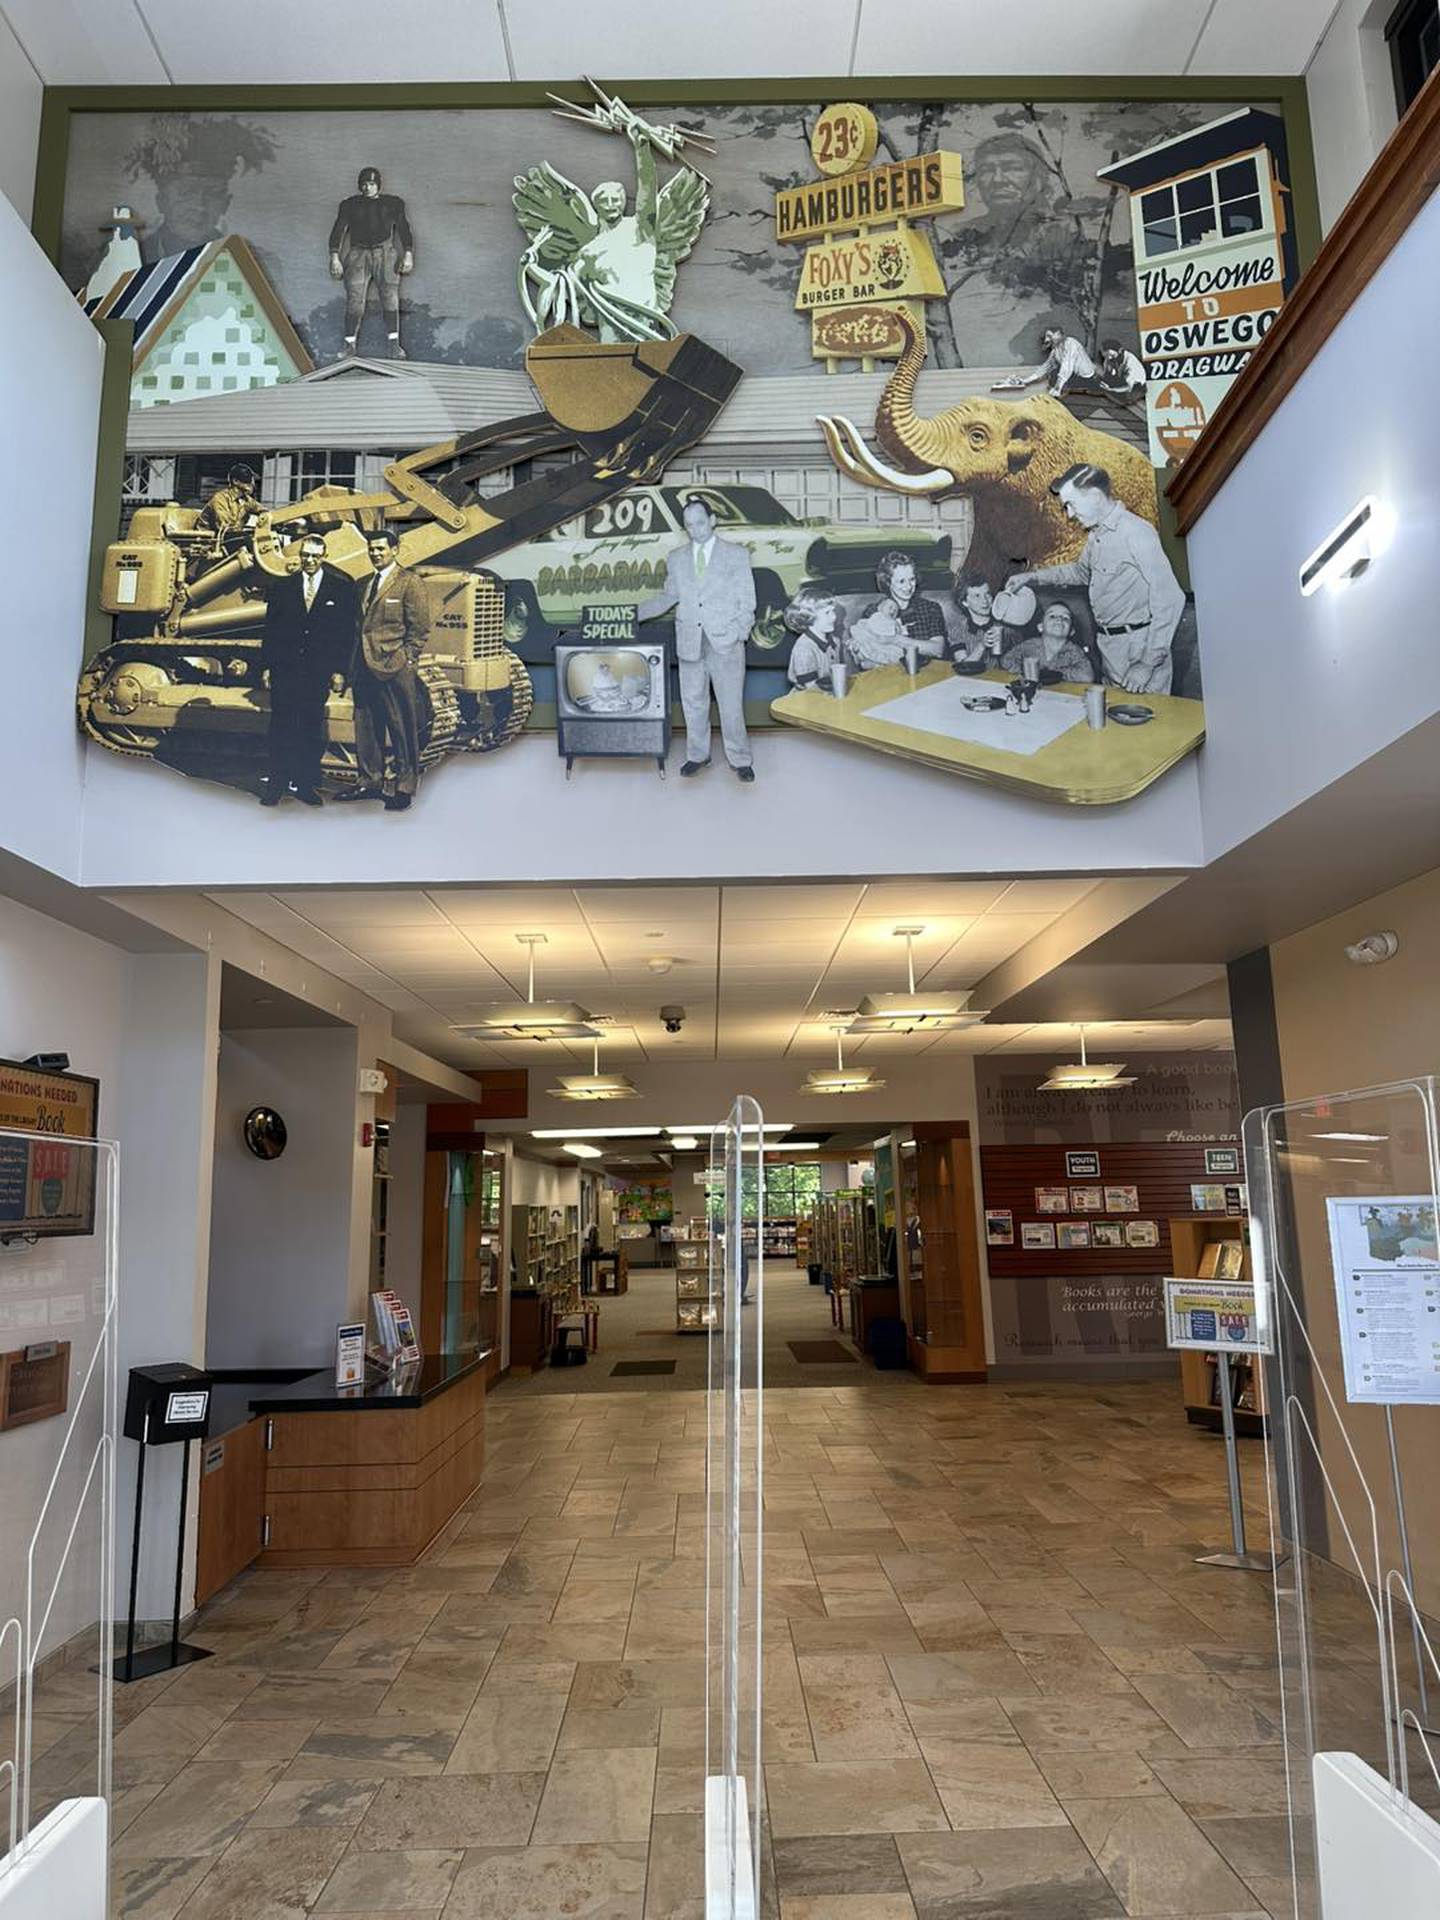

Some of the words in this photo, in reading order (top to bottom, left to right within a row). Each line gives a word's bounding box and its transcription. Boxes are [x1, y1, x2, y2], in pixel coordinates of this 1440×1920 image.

[818, 117, 859, 164] 23¢
[779, 164, 940, 233] HAMBURGERS
[809, 243, 872, 288] FOXY'S
[1139, 257, 1274, 304] Welcome
[802, 288, 845, 304] BURGER
[853, 284, 876, 298] BAR
[1182, 297, 1219, 320] TO
[1145, 310, 1277, 354] OSWEGO
[591, 497, 654, 533] 209
[443, 613, 462, 621] CAT
[588, 606, 635, 621] TODAYS
[583, 623, 635, 639] SPECIAL
[44, 1087, 77, 1104] NEEDED
[36, 1103, 65, 1134] Book
[1165, 1130, 1216, 1142] Choose
[1219, 1133, 1238, 1142] an
[1070, 1156, 1096, 1165] YOUTH
[1064, 1284, 1101, 1297] Books
[1106, 1286, 1131, 1297] are
[1135, 1282, 1157, 1296] the
[1180, 1287, 1225, 1297] DONATIONS
[1062, 1297, 1158, 1311] accumulated
